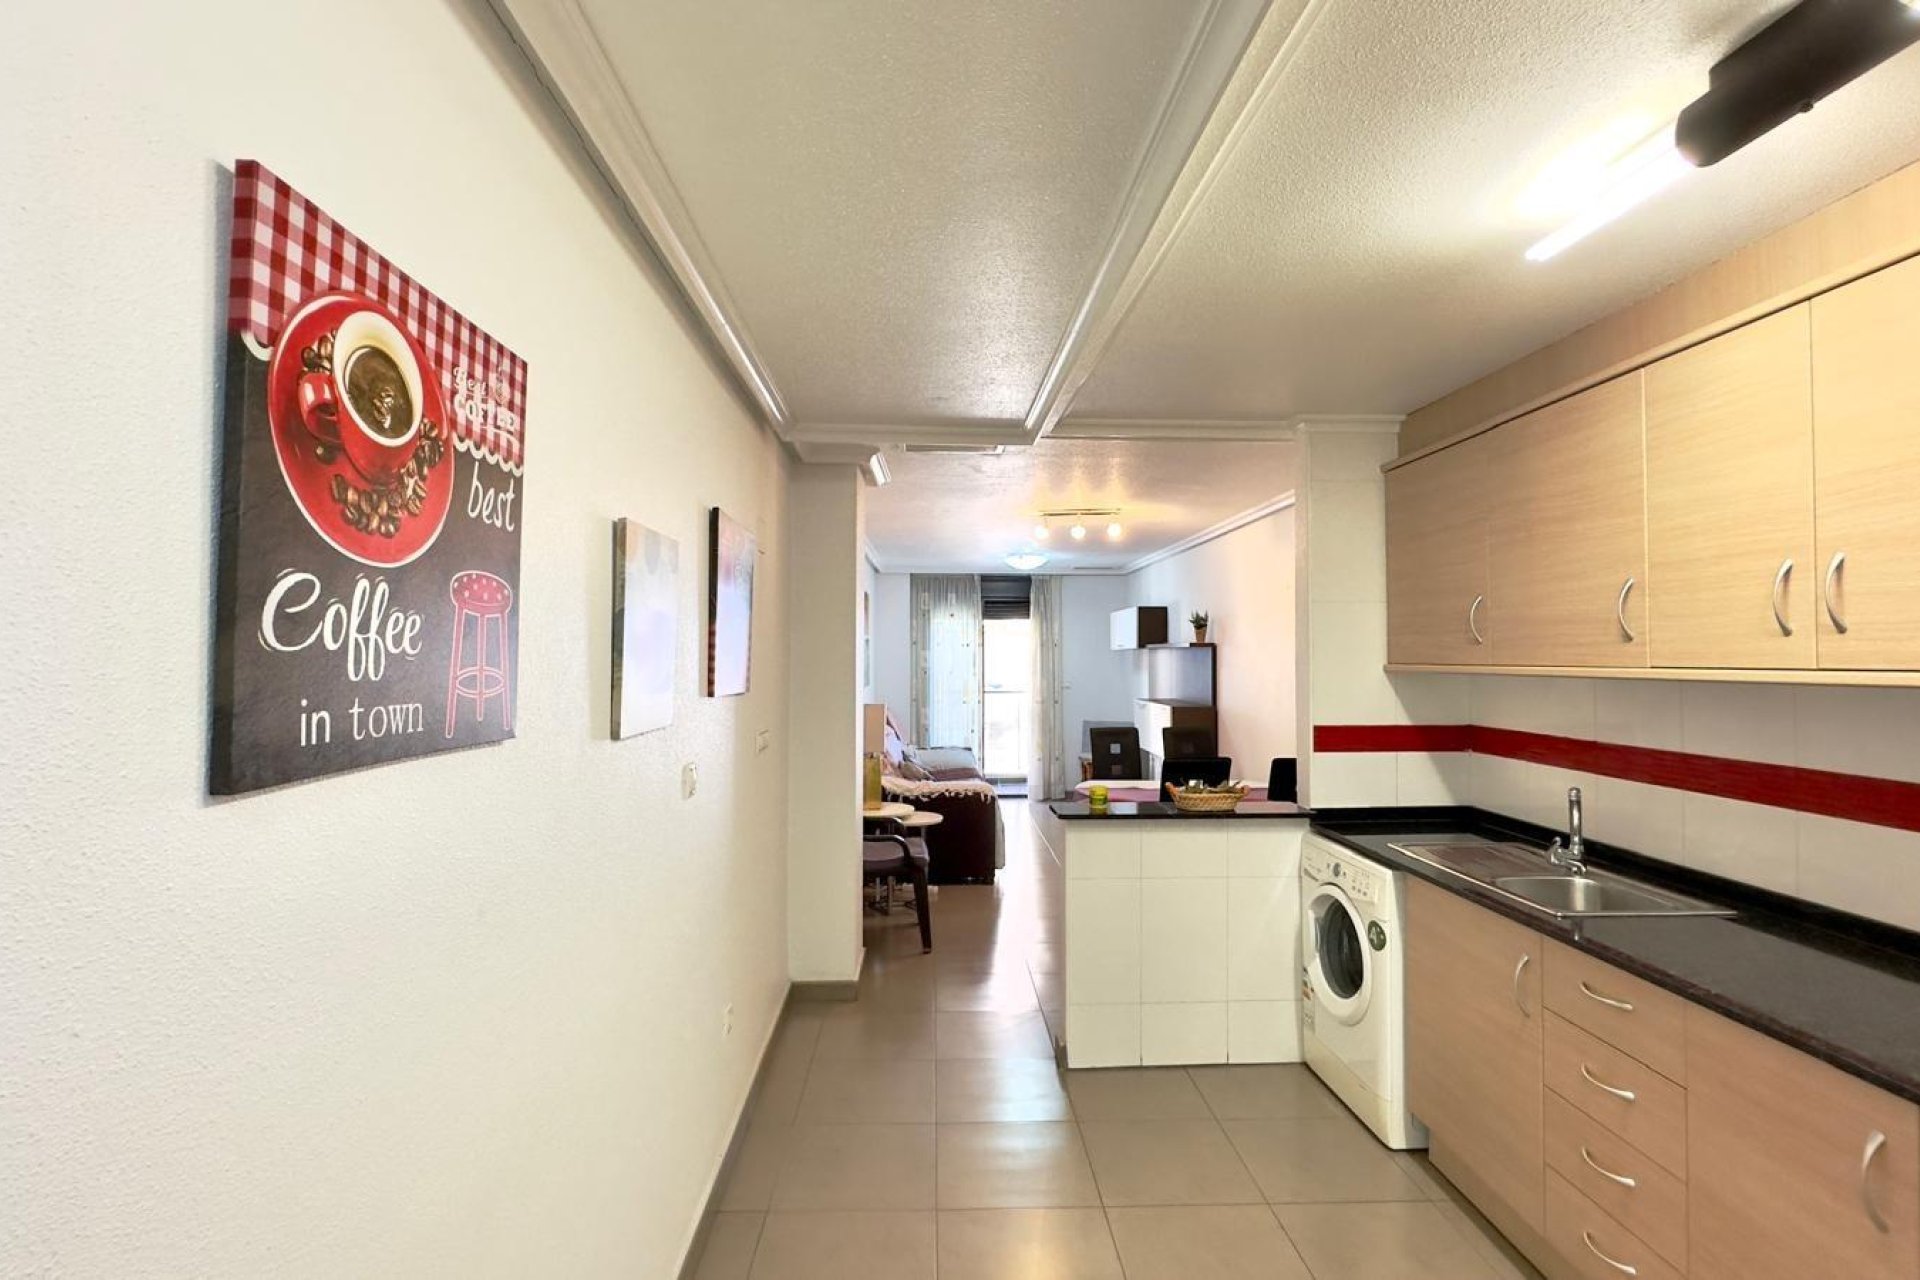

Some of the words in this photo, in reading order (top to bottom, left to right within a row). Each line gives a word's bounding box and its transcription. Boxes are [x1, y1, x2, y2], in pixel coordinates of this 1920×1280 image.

[468, 460, 516, 532] best
[259, 569, 423, 682] Coffee
[301, 698, 331, 747] in
[349, 697, 423, 741] town
